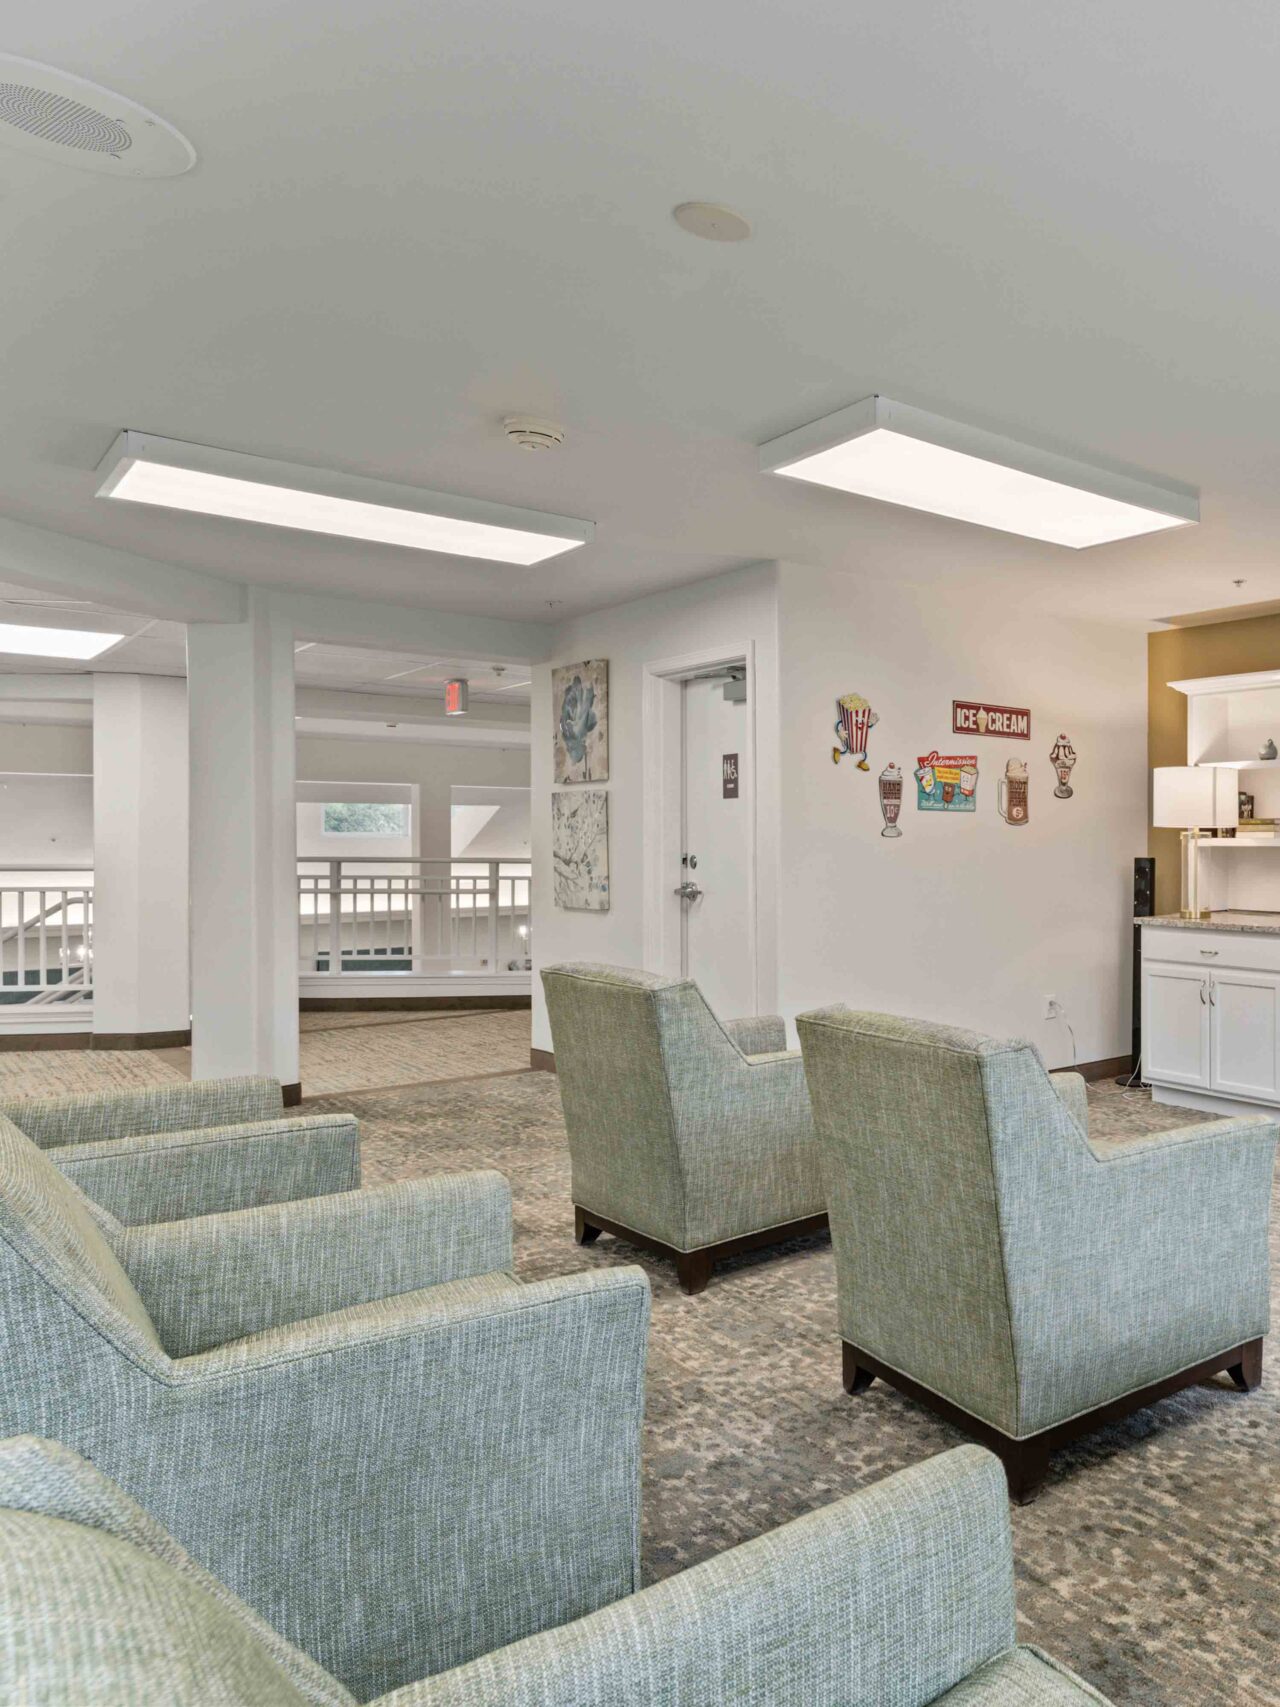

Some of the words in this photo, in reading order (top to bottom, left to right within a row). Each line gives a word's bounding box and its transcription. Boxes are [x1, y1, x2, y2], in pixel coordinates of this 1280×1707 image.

[956, 708, 977, 729] ICE
[988, 711, 1028, 735] CREAM
[924, 752, 977, 767] Intermission
